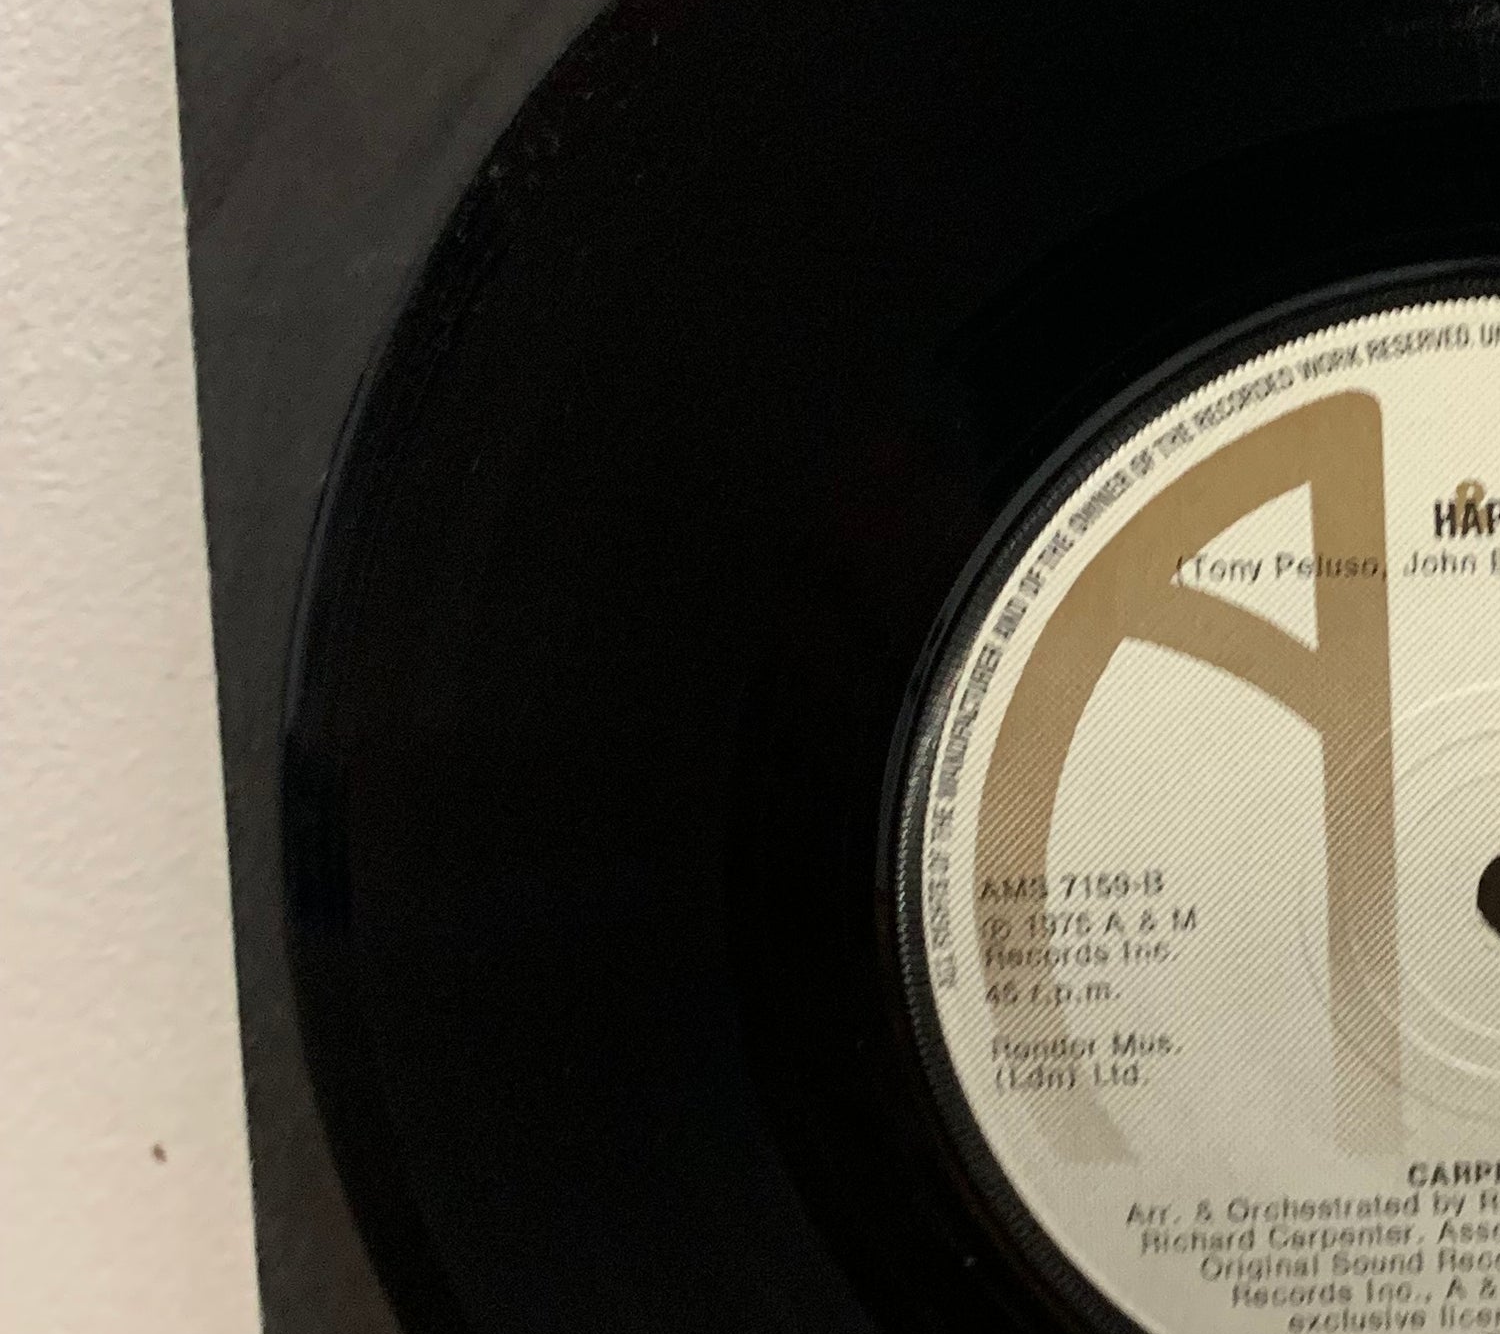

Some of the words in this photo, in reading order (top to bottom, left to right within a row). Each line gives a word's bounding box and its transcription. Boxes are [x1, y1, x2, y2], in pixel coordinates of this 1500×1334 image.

[1018, 569, 1045, 597] OF
[1037, 532, 1072, 570] THE
[1127, 450, 1155, 477] OF
[1154, 422, 1193, 457] THE
[1299, 343, 1361, 381] WORK
[1174, 553, 1263, 588] (Tony
[1403, 547, 1478, 578] John
[979, 874, 1048, 904] AMS
[1060, 870, 1164, 899] 7159-B
[1103, 911, 1125, 936] A
[1138, 907, 1157, 934] &
[1171, 904, 1197, 931] M
[984, 941, 1110, 969] Records
[985, 980, 1018, 1006] 45
[1125, 1201, 1183, 1227] Arr.
[1194, 1197, 1214, 1225] &
[1226, 1191, 1421, 1225] Orchestrated
[1432, 1190, 1468, 1218] by
[1140, 1227, 1255, 1256] Richard
[1199, 1253, 1320, 1283] Original
[1331, 1247, 1425, 1277] Sound
[1230, 1281, 1353, 1310] Records
[1445, 1273, 1469, 1301] A
[1478, 1274, 1498, 1301] &
